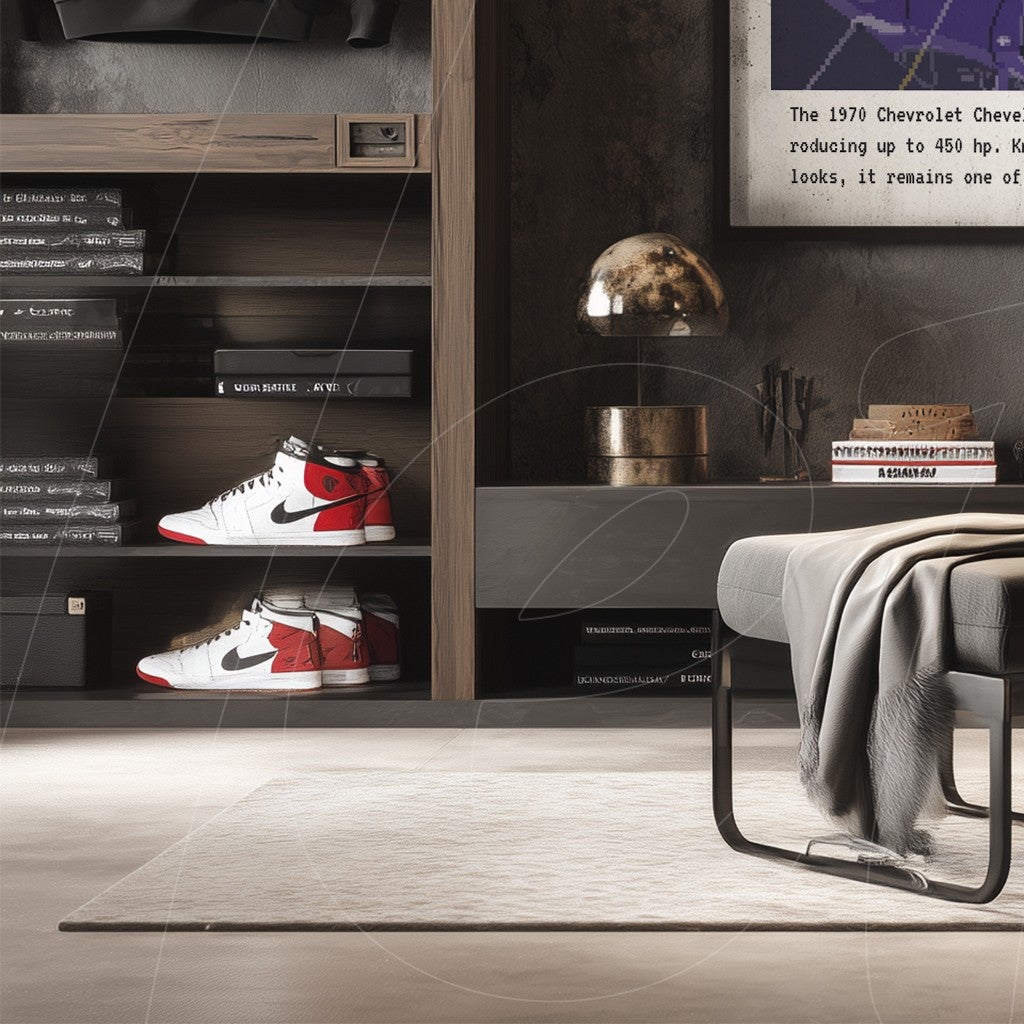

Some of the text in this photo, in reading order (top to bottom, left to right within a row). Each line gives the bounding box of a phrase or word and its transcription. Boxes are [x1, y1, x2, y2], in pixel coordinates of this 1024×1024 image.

[789, 106, 819, 122] The
[829, 106, 867, 122] 1970
[876, 106, 963, 122] Chevrolet
[789, 137, 867, 157] roducing
[877, 141, 896, 157] up
[905, 137, 925, 153] to
[934, 137, 963, 154] 450
[973, 138, 1002, 158] hp.
[791, 168, 847, 188] looks,
[858, 168, 876, 184] it
[886, 168, 953, 185] remains
[963, 172, 992, 185] one
[1002, 168, 1021, 185] of
